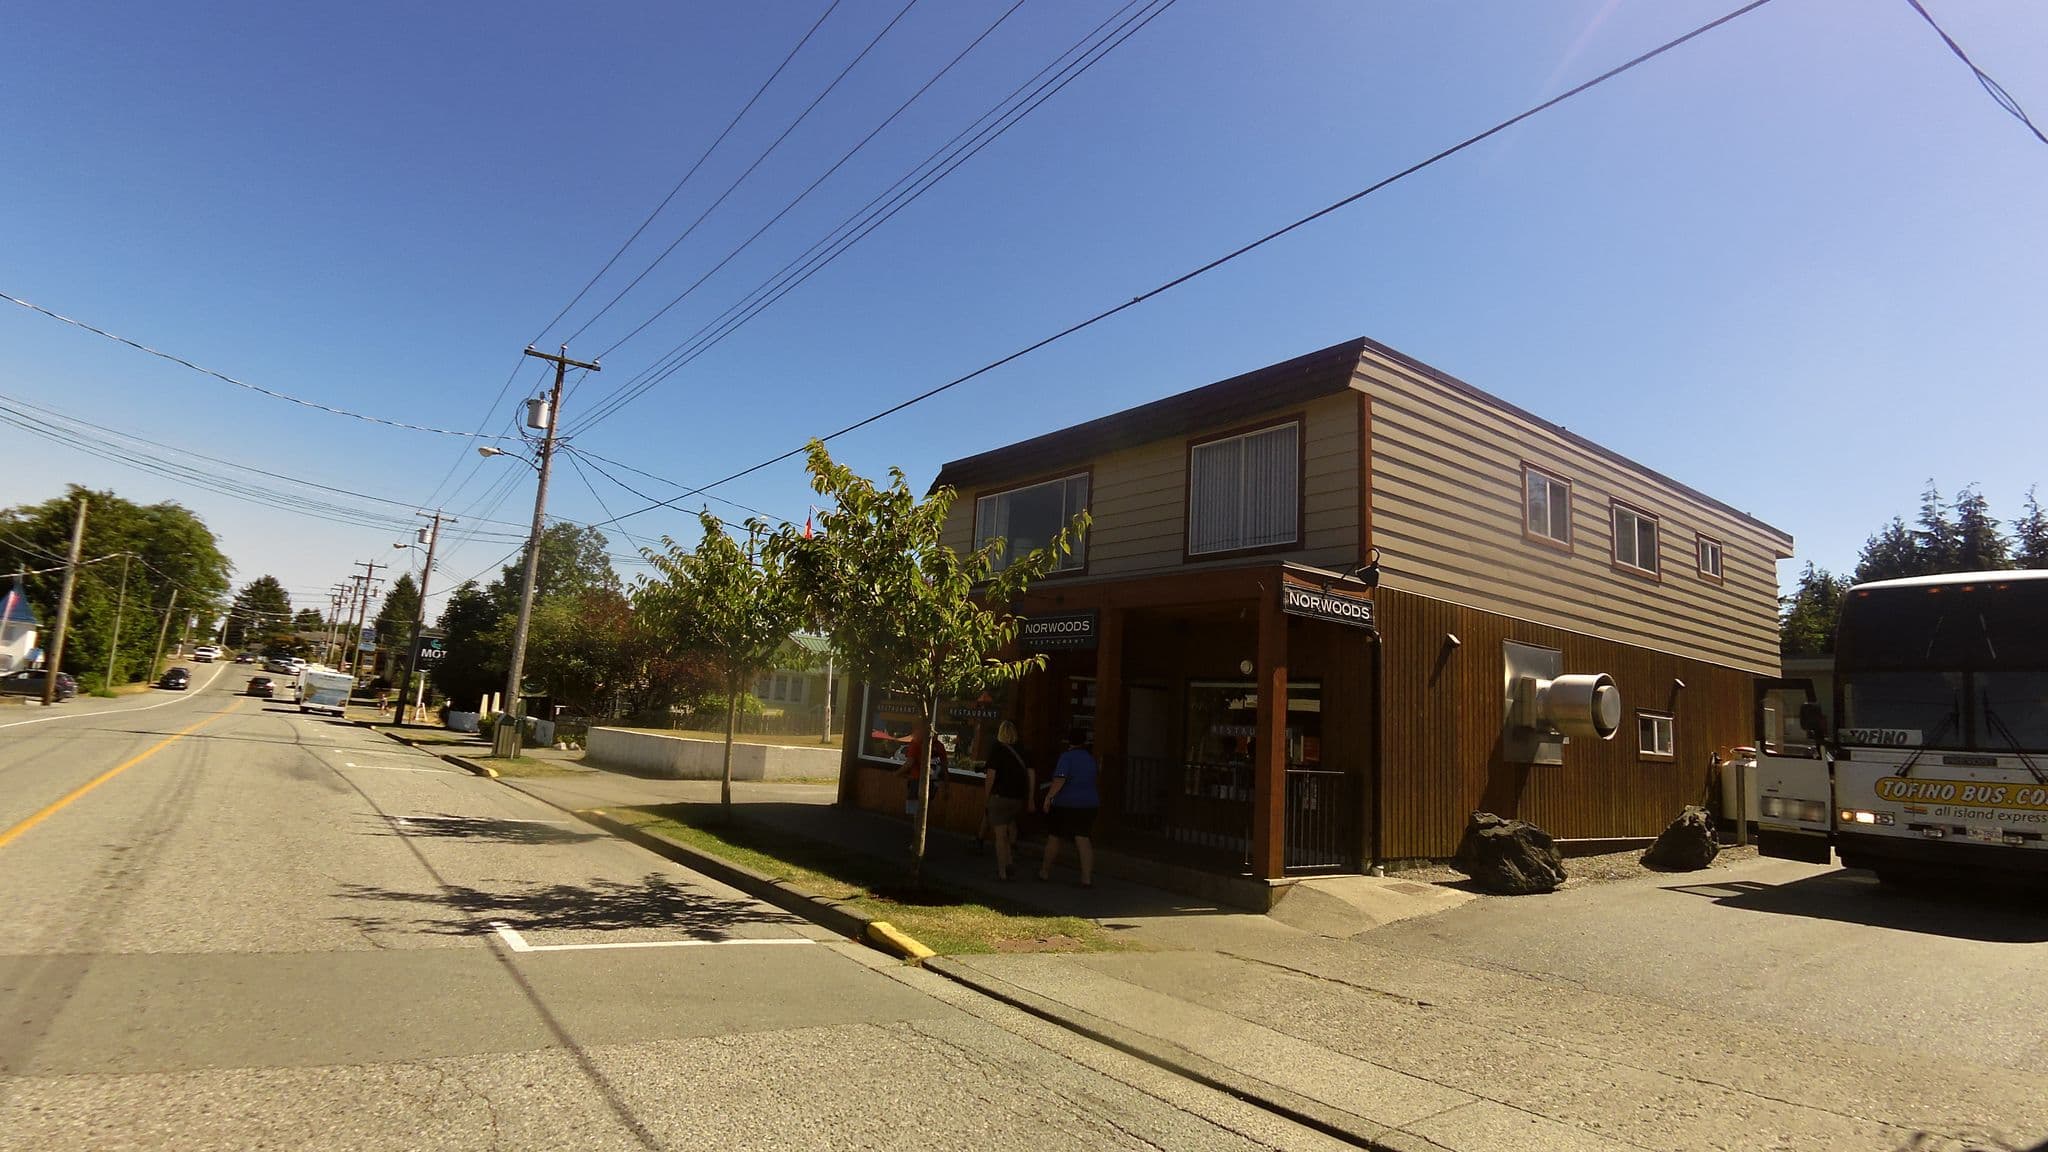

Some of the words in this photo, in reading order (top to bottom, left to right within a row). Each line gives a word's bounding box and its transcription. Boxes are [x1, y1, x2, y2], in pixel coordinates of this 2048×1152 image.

[1289, 591, 1370, 620] NORWOODS
[1025, 620, 1090, 634] NORWOODS
[421, 648, 448, 659] MOT
[950, 707, 998, 719] RESTAURANT
[1883, 780, 1956, 801] TOFINO
[1934, 806, 1951, 817] all
[1954, 807, 1994, 820] island
[1997, 811, 2048, 824] express
